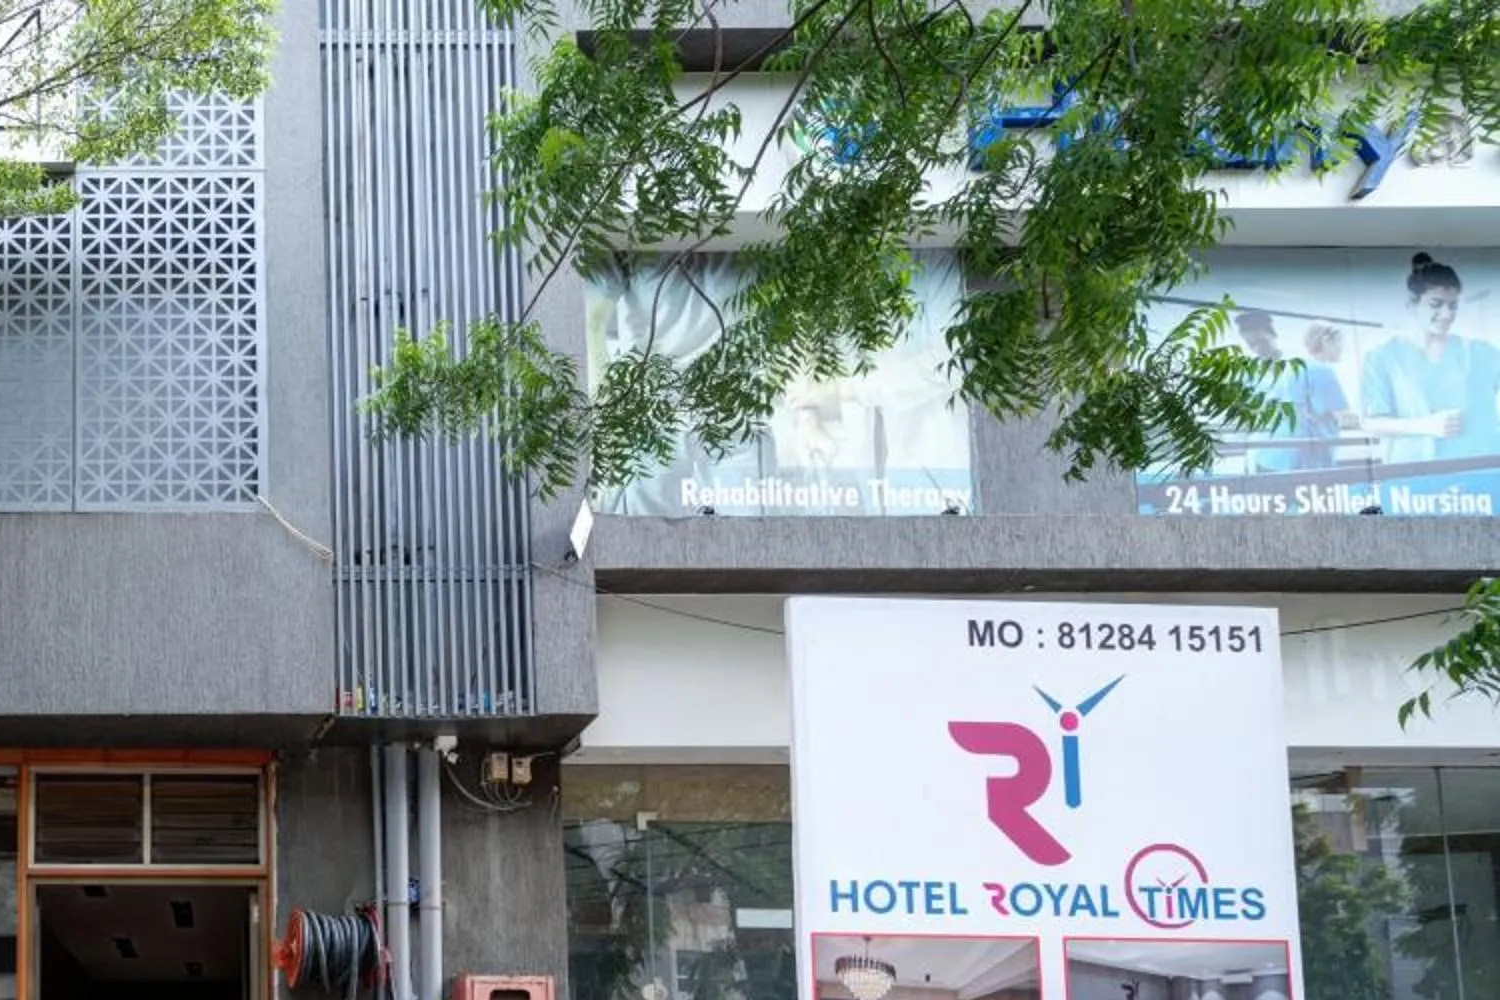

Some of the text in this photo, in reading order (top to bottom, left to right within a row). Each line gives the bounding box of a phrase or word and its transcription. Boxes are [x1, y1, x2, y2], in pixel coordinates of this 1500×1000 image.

[681, 478, 859, 506] Rehabilitative
[1165, 486, 1200, 514] 24
[1209, 486, 1287, 514] Hours
[1295, 484, 1381, 514] Skilled
[968, 620, 1024, 648] MO
[1058, 623, 1156, 650] 81284
[1169, 625, 1263, 652] 15151
[830, 880, 968, 915] HOTEL
[982, 882, 1119, 917] ROYAL
